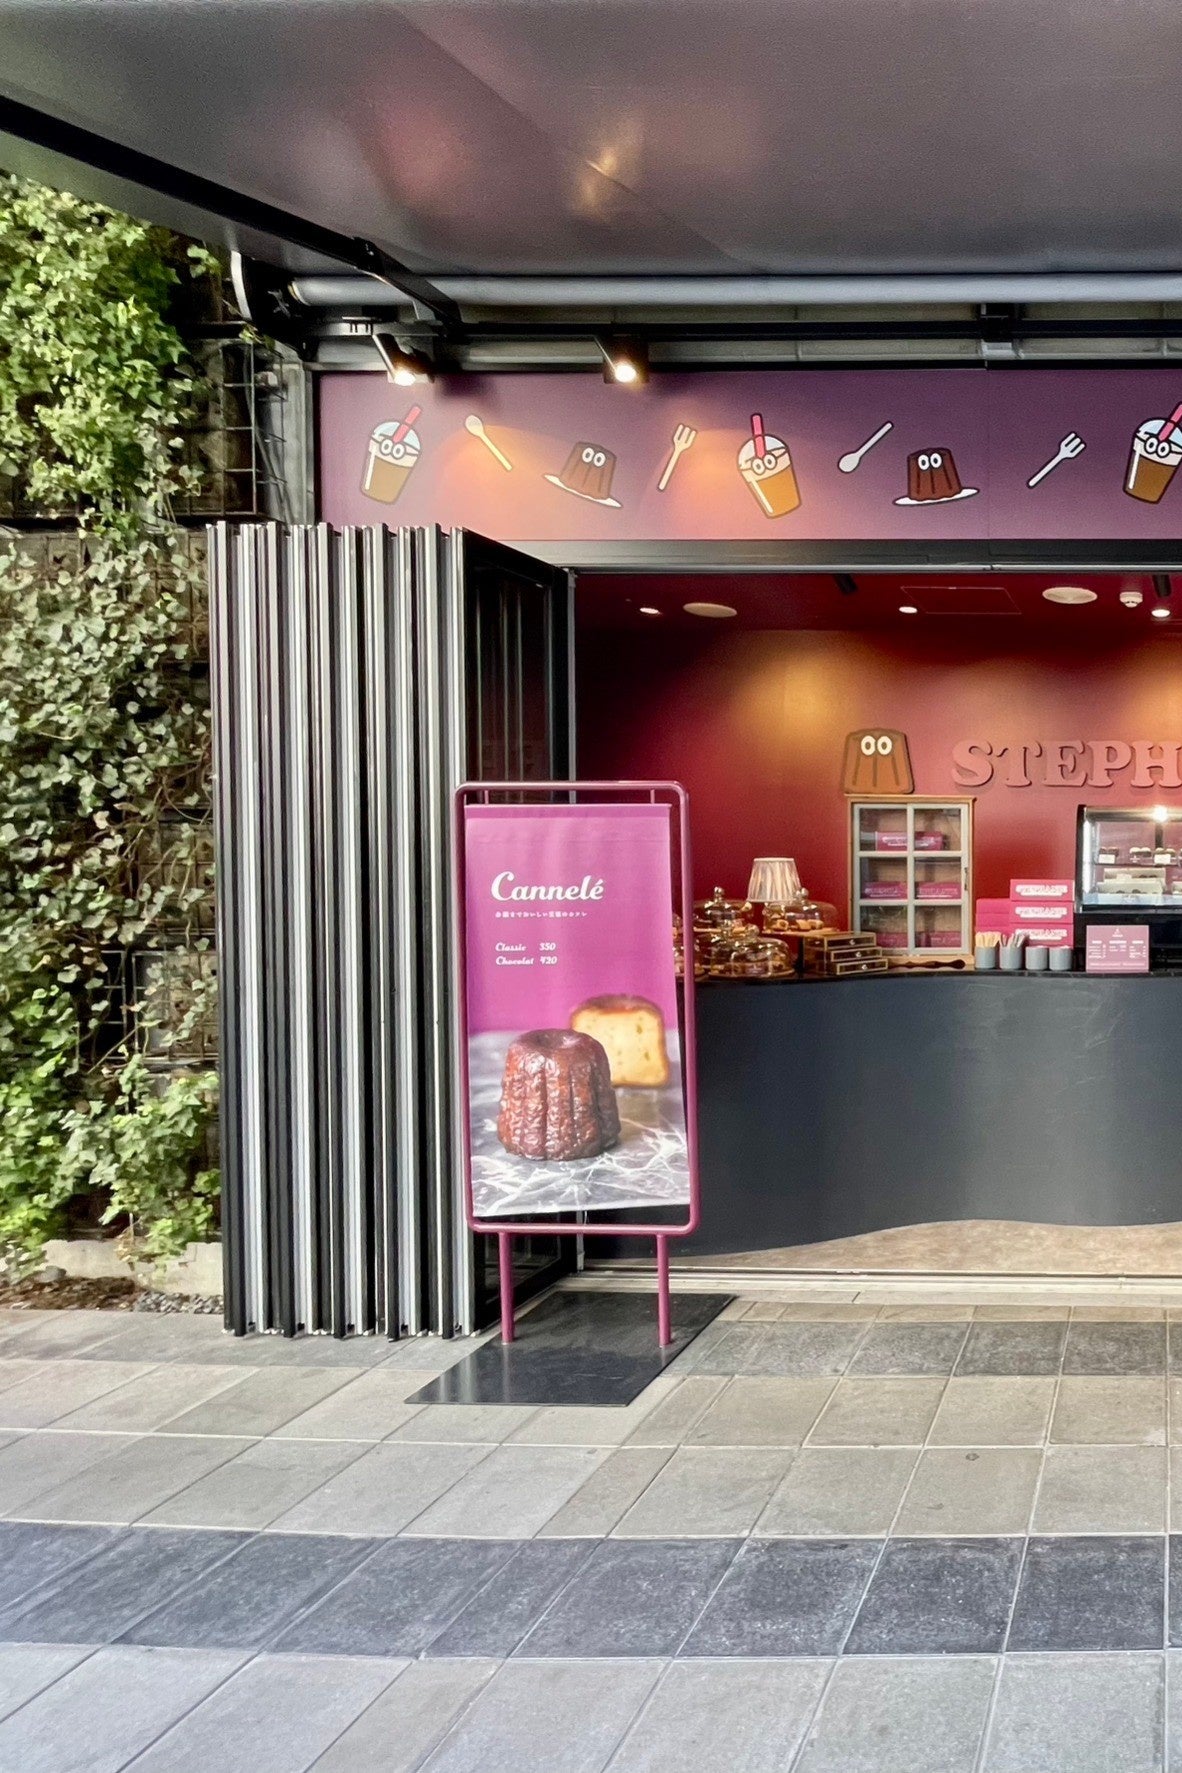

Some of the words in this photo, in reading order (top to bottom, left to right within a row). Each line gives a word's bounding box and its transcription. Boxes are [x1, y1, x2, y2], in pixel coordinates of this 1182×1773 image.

[491, 871, 604, 901] Cannelé
[495, 942, 527, 952] Classic
[539, 942, 556, 951] 350
[495, 955, 534, 966] Chocolat
